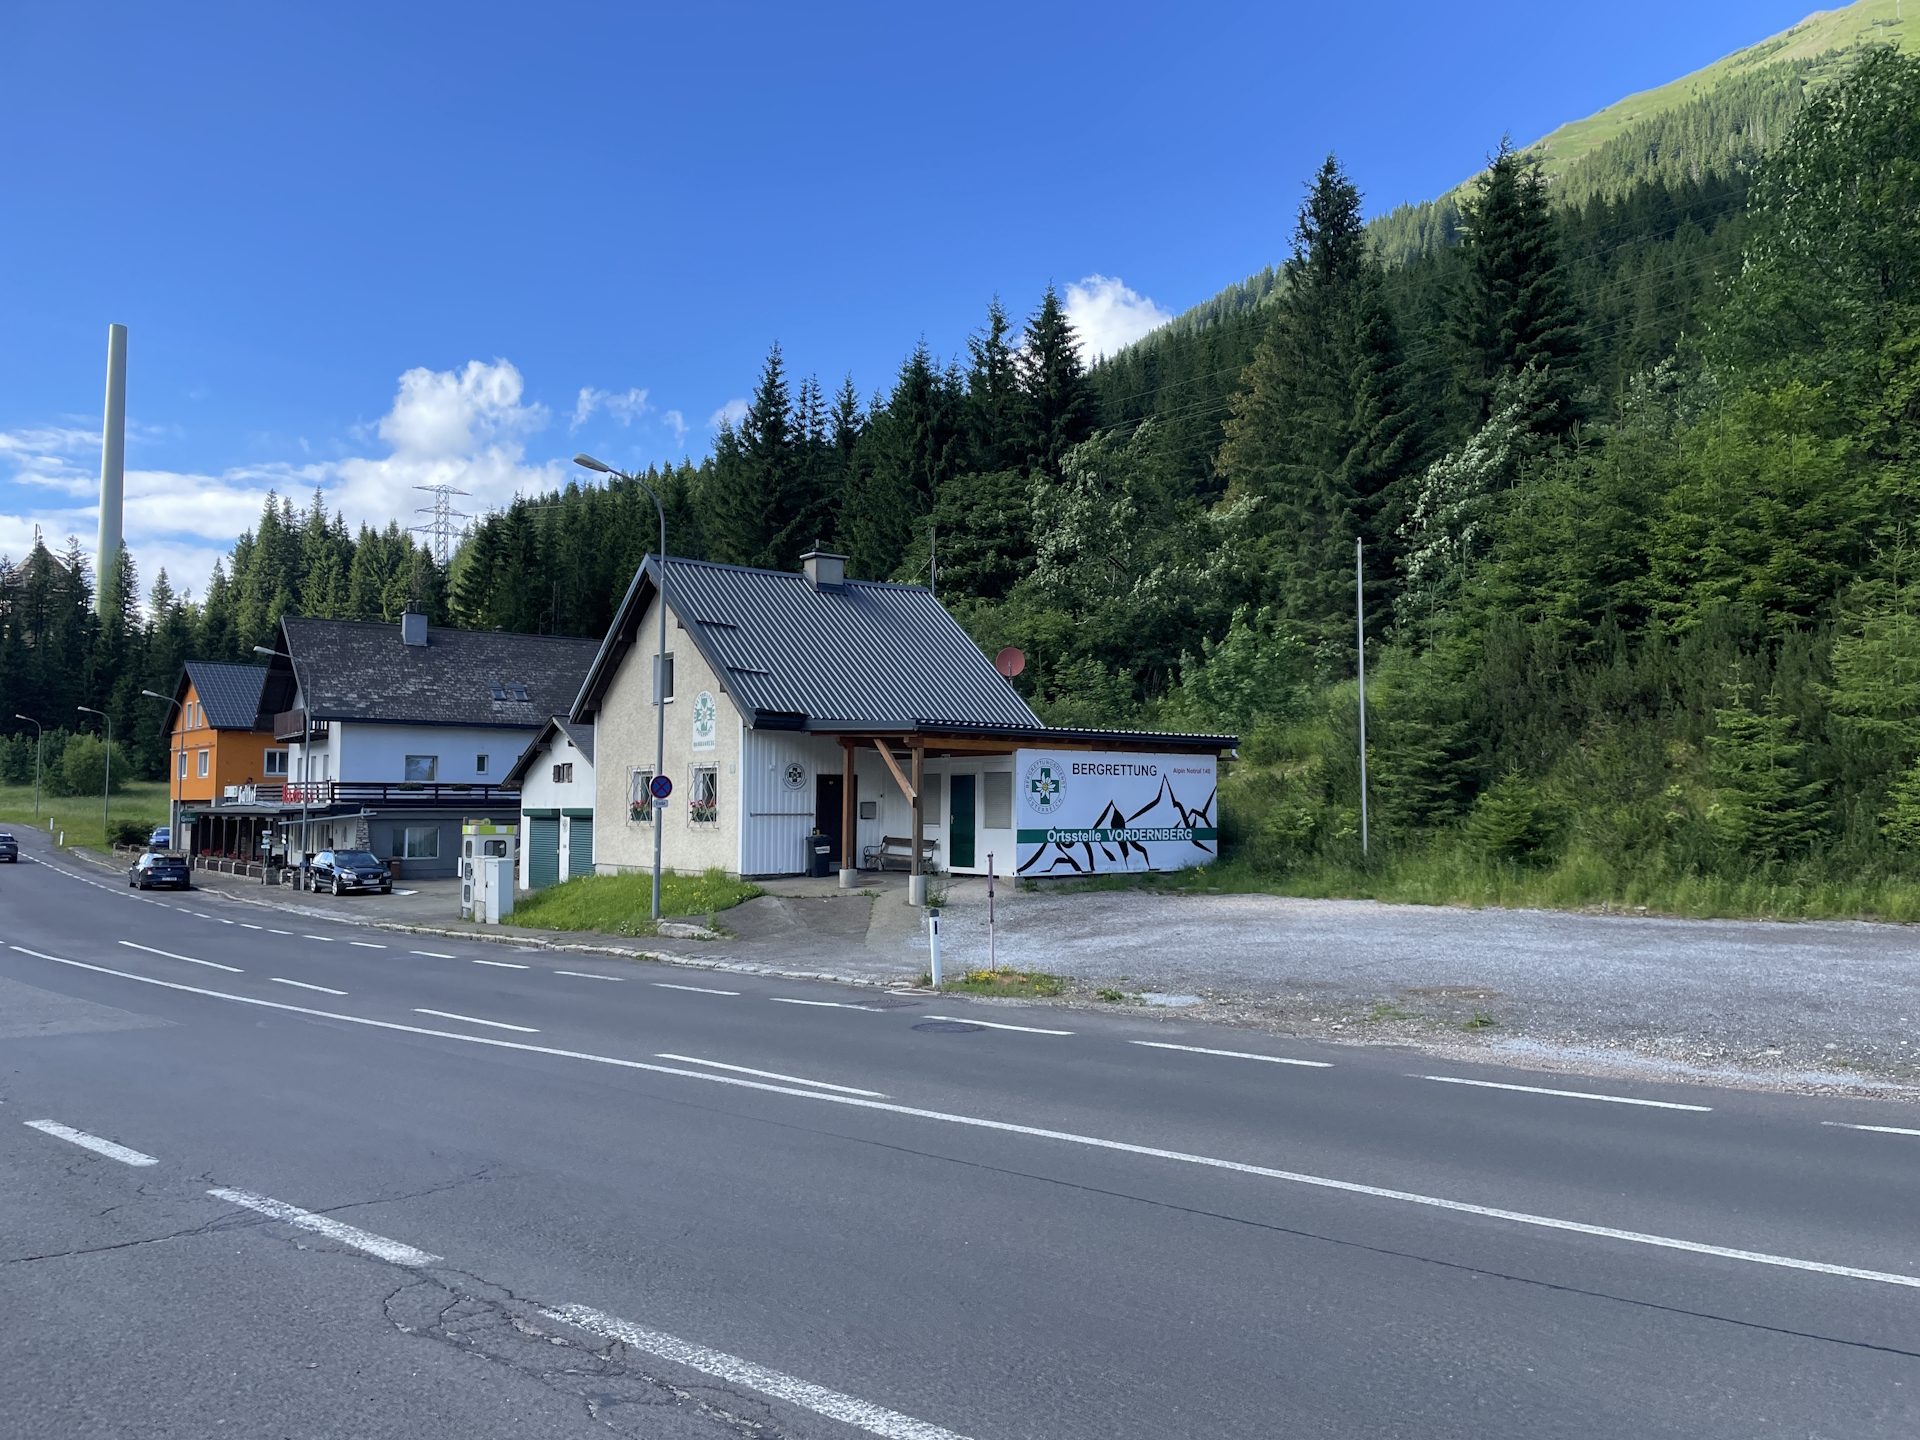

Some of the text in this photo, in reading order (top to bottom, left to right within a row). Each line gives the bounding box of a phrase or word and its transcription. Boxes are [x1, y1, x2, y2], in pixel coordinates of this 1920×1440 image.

[1072, 762, 1157, 777] BERGRETTUNG
[1173, 767, 1186, 775] Alpin
[1186, 767, 1202, 775] Notruf
[1046, 828, 1193, 843] Ortsstelle VORDERNBERG
